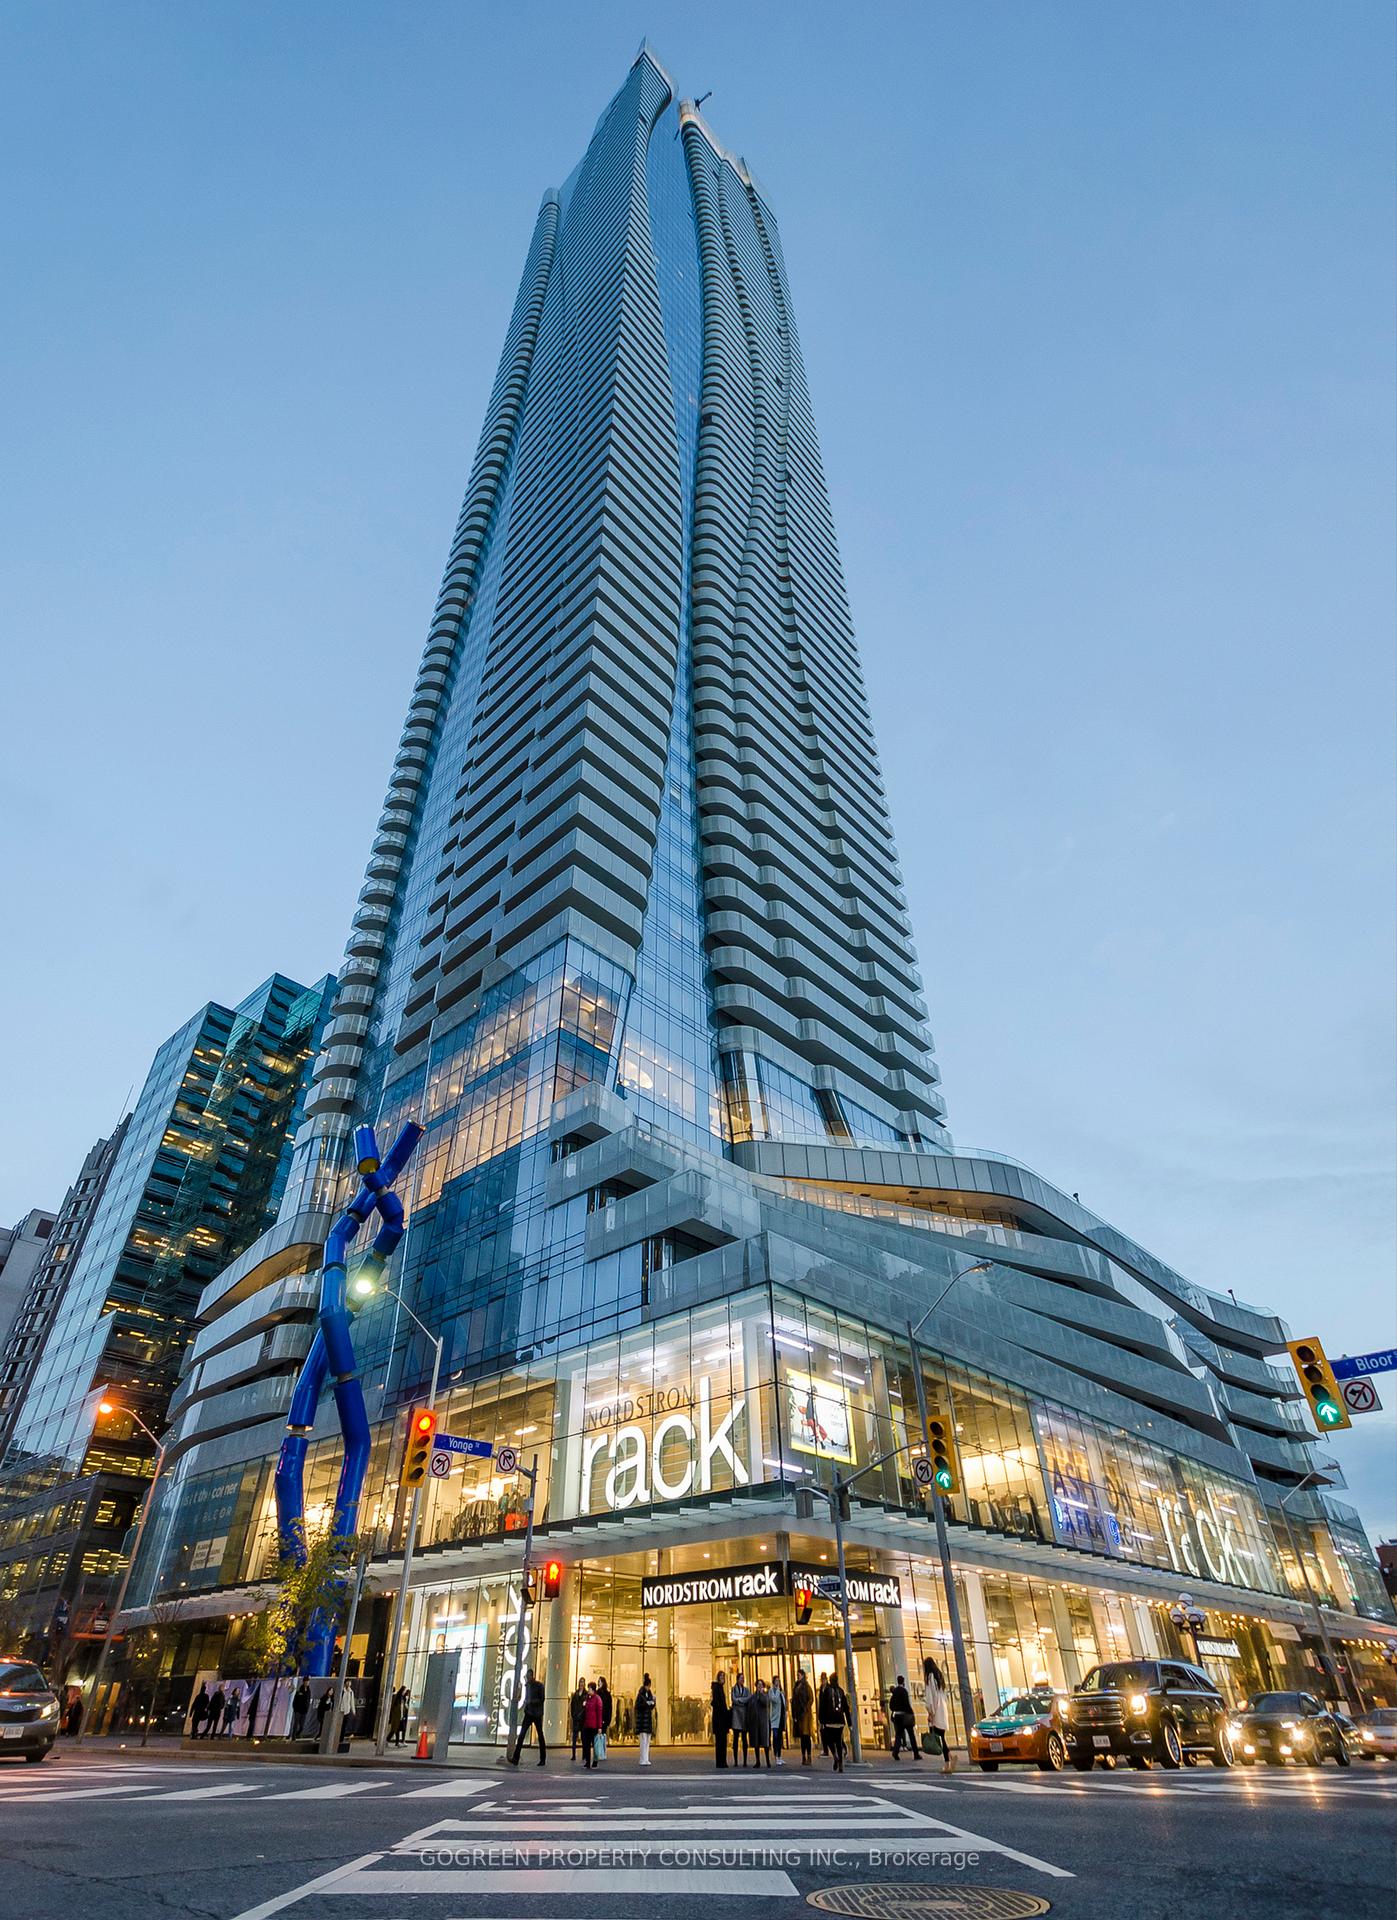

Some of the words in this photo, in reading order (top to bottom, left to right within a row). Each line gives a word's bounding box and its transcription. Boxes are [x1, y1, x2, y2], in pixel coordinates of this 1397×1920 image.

[1355, 1355, 1393, 1371] Bloor
[587, 1384, 696, 1429] NORDSTROM
[448, 1436, 474, 1453] Yonge
[579, 1376, 749, 1515] rack
[643, 1576, 733, 1606] NORDSTROM
[734, 1565, 779, 1597] rack
[870, 1578, 901, 1605] rack
